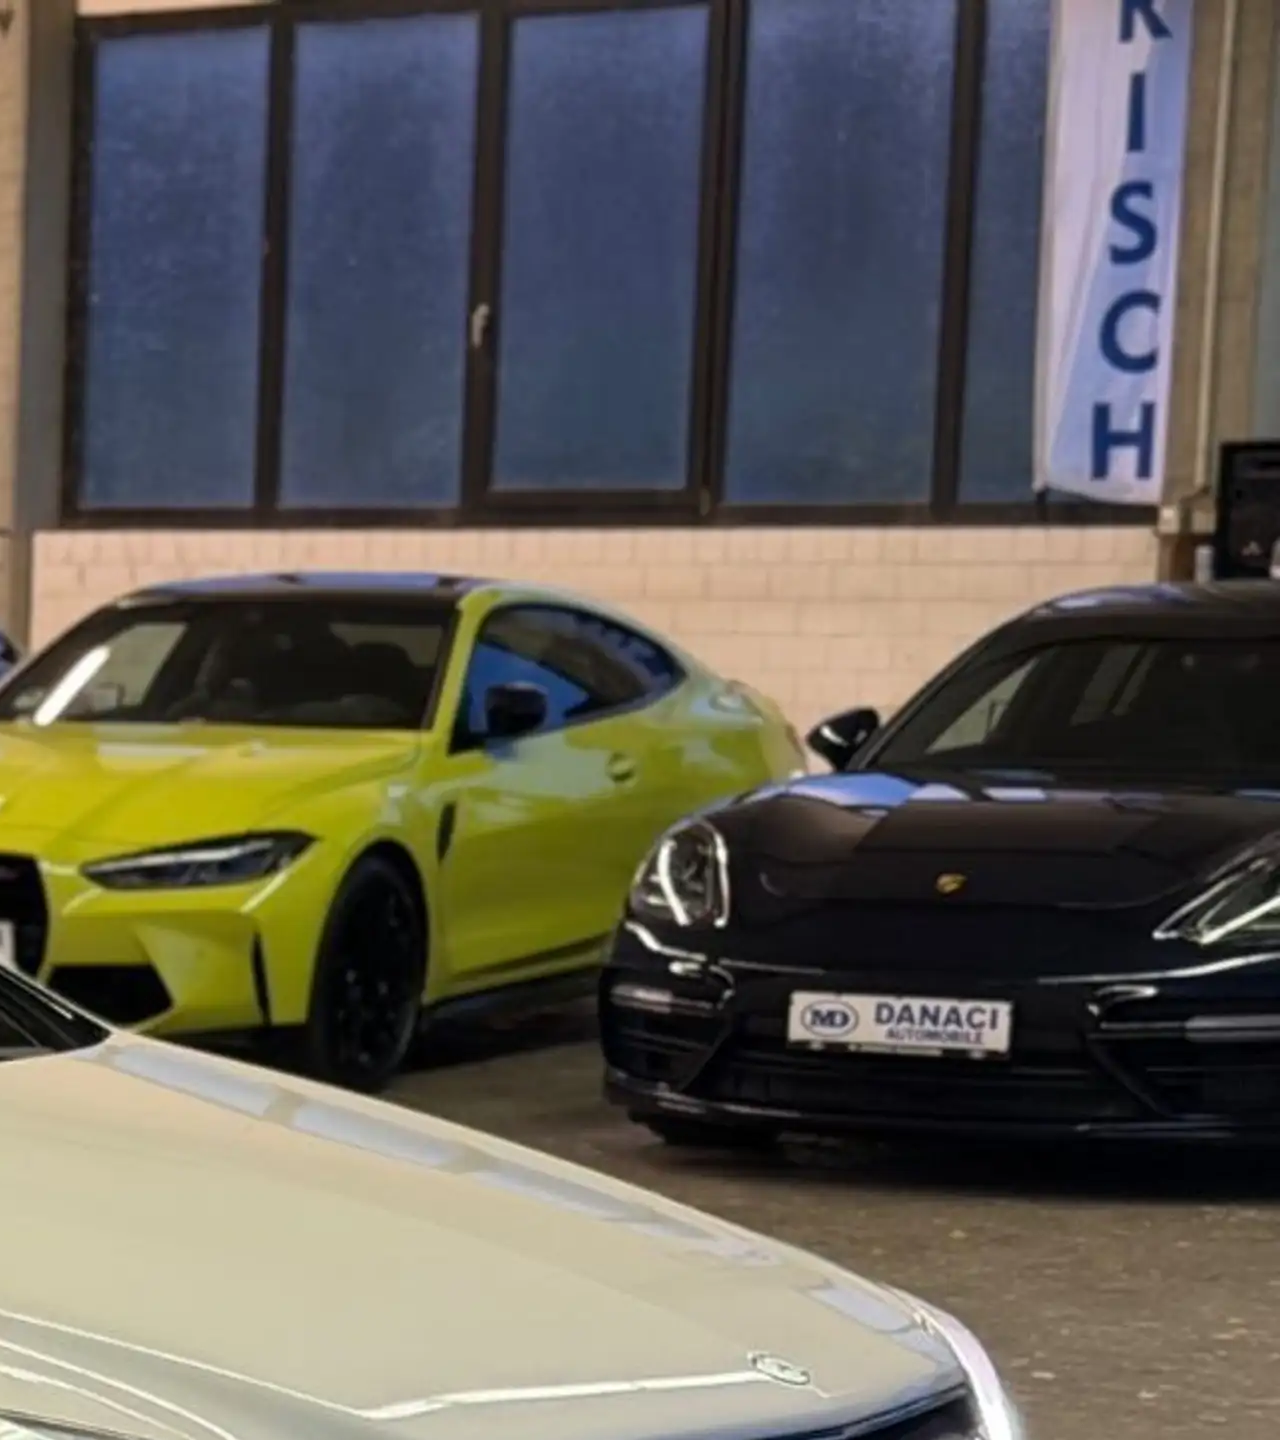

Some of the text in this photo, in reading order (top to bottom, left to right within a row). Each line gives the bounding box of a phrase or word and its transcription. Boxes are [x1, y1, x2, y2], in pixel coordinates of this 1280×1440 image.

[810, 1001, 999, 1030] MD DANACI
[884, 1028, 986, 1046] AUTOMOBILE
